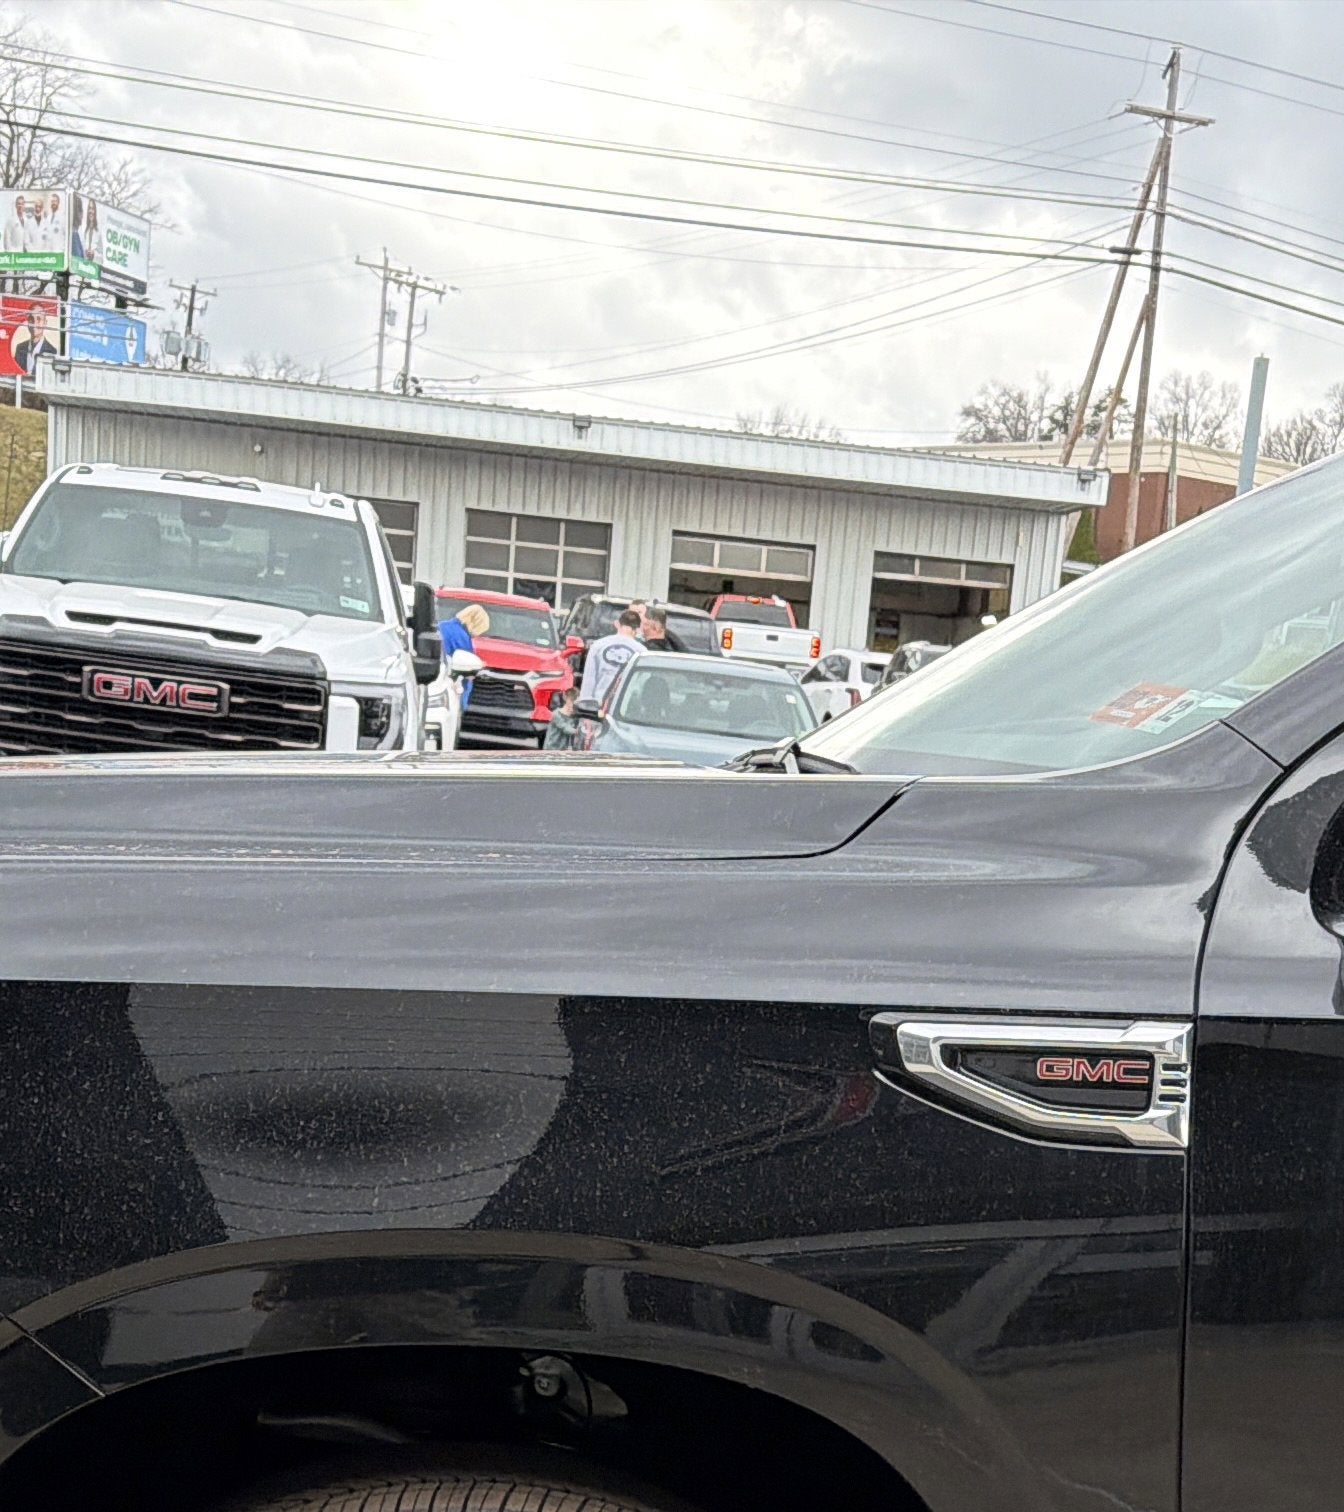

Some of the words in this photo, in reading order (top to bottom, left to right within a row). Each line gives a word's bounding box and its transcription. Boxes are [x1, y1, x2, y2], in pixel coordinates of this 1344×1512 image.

[106, 228, 140, 254] OB/GYN
[105, 247, 129, 267] CARE
[94, 673, 219, 712] GMC
[1036, 1057, 1150, 1084] GMC
